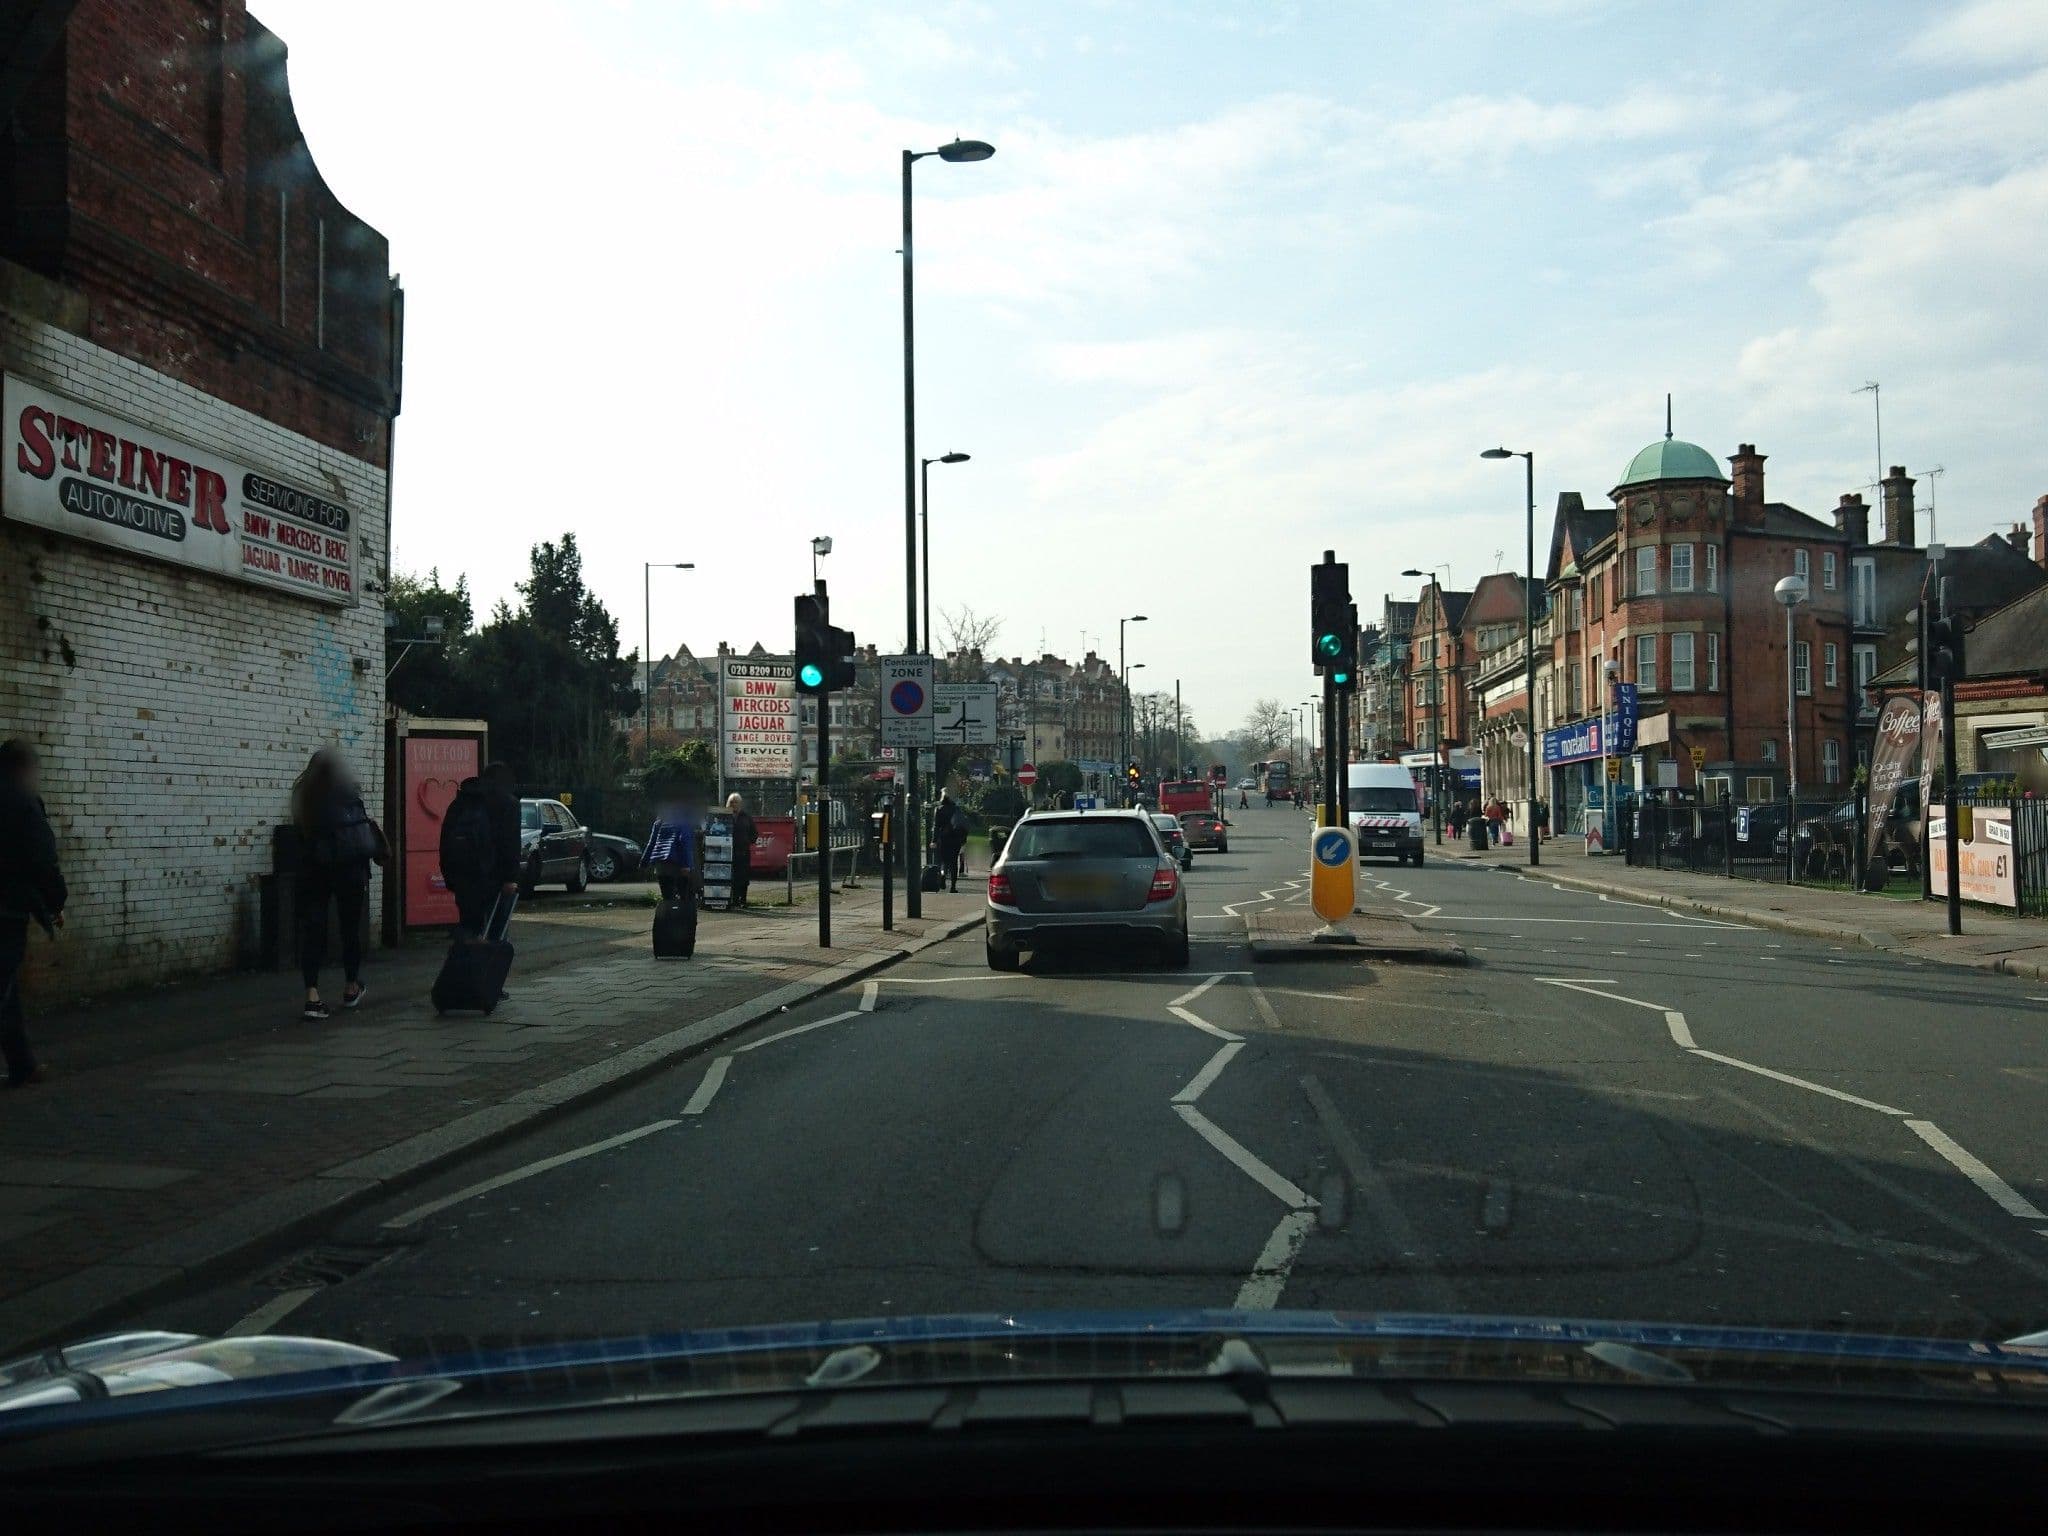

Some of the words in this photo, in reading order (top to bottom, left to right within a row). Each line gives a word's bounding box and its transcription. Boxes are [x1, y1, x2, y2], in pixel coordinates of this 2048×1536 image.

[17, 405, 232, 535] STEINER
[249, 477, 316, 518] SERVICING
[319, 504, 345, 527] FOR
[65, 483, 181, 538] AUTOMOTIVE
[243, 511, 270, 537] BMW
[276, 522, 322, 554] MERCEDES
[325, 535, 349, 564] BENZ
[242, 543, 281, 574] JAGUAR
[287, 555, 321, 586] RANGE
[322, 565, 351, 594] ROVER
[884, 659, 930, 667] Controlled
[730, 665, 747, 675] 020
[749, 665, 771, 676] 8209
[773, 666, 792, 677] 1120
[890, 668, 924, 678] ZONE
[745, 681, 777, 695] BMW
[732, 698, 791, 713] MERCEDES
[738, 716, 785, 730] JAGUAR
[1621, 685, 1633, 749] UNIQUE
[1880, 709, 1921, 739] Coffee
[731, 732, 759, 742] RANGE
[764, 733, 792, 743] ROVER
[734, 747, 789, 755] SERVICE
